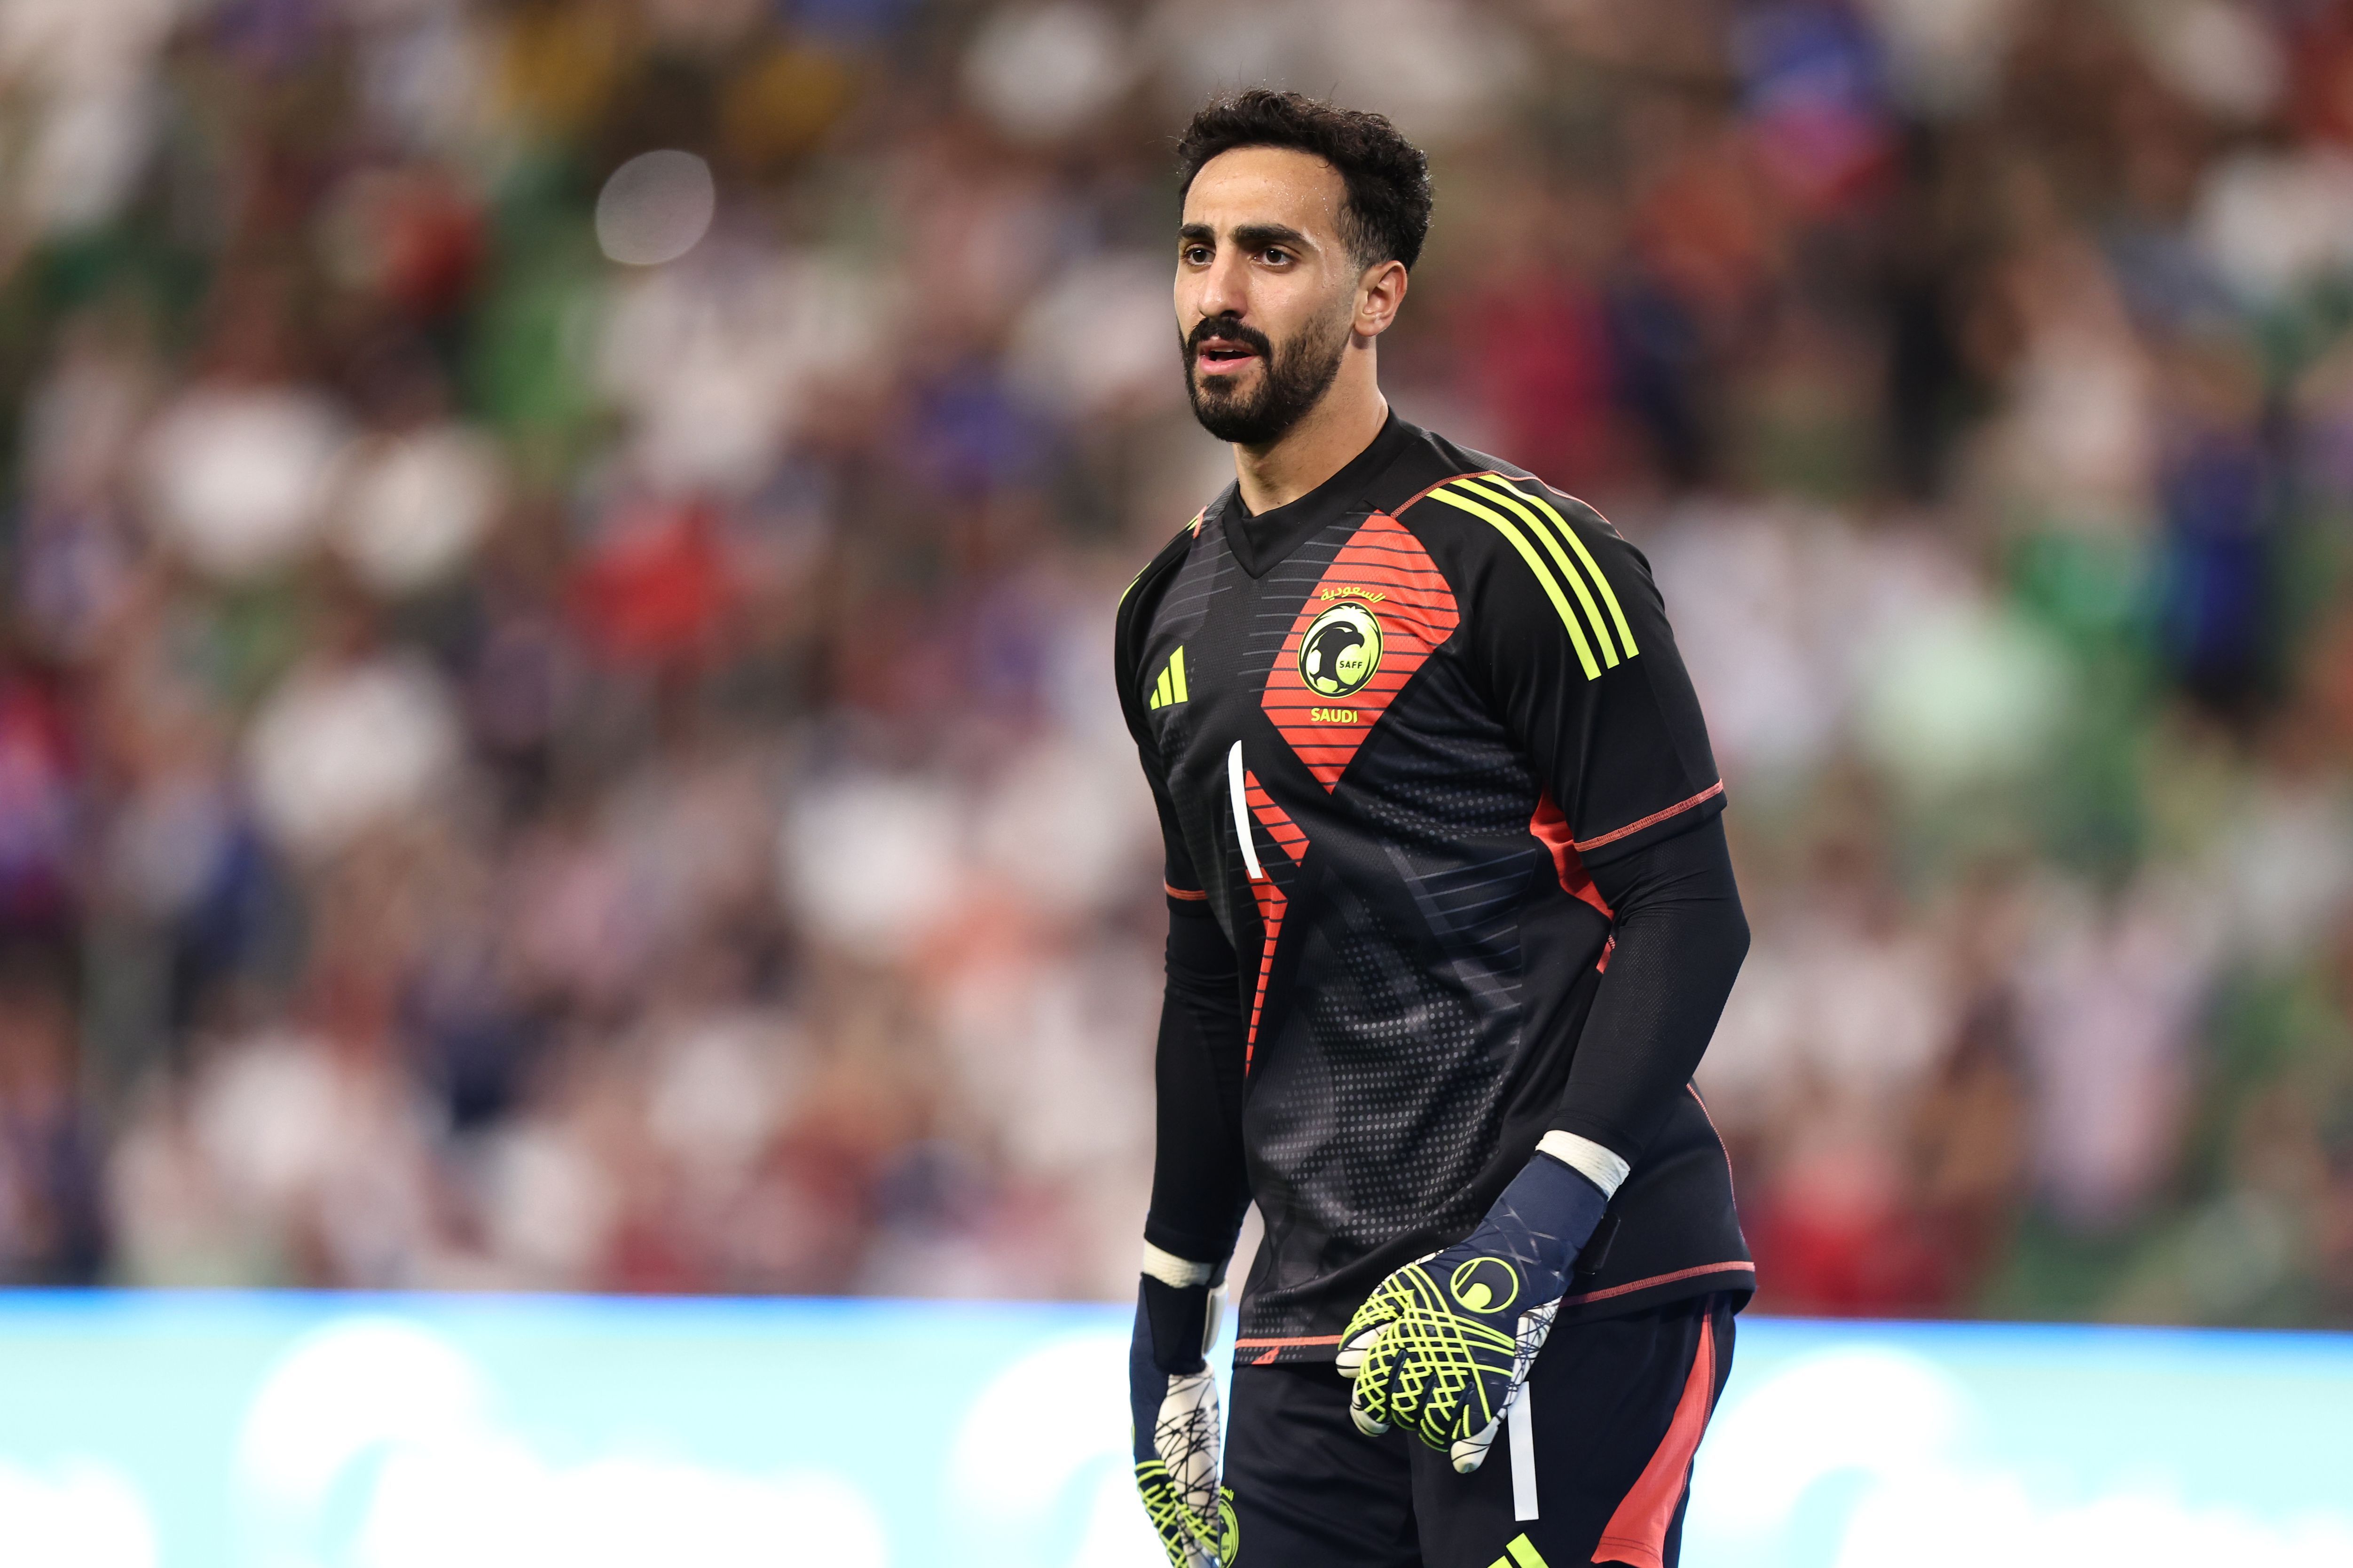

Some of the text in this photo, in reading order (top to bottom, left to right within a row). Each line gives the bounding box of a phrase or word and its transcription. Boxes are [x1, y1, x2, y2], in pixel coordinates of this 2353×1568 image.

[1320, 586, 1386, 604] السعودية
[1339, 660, 1363, 669] SAFF
[1310, 707, 1358, 724] SAUDI
[1228, 739, 1264, 879] 1
